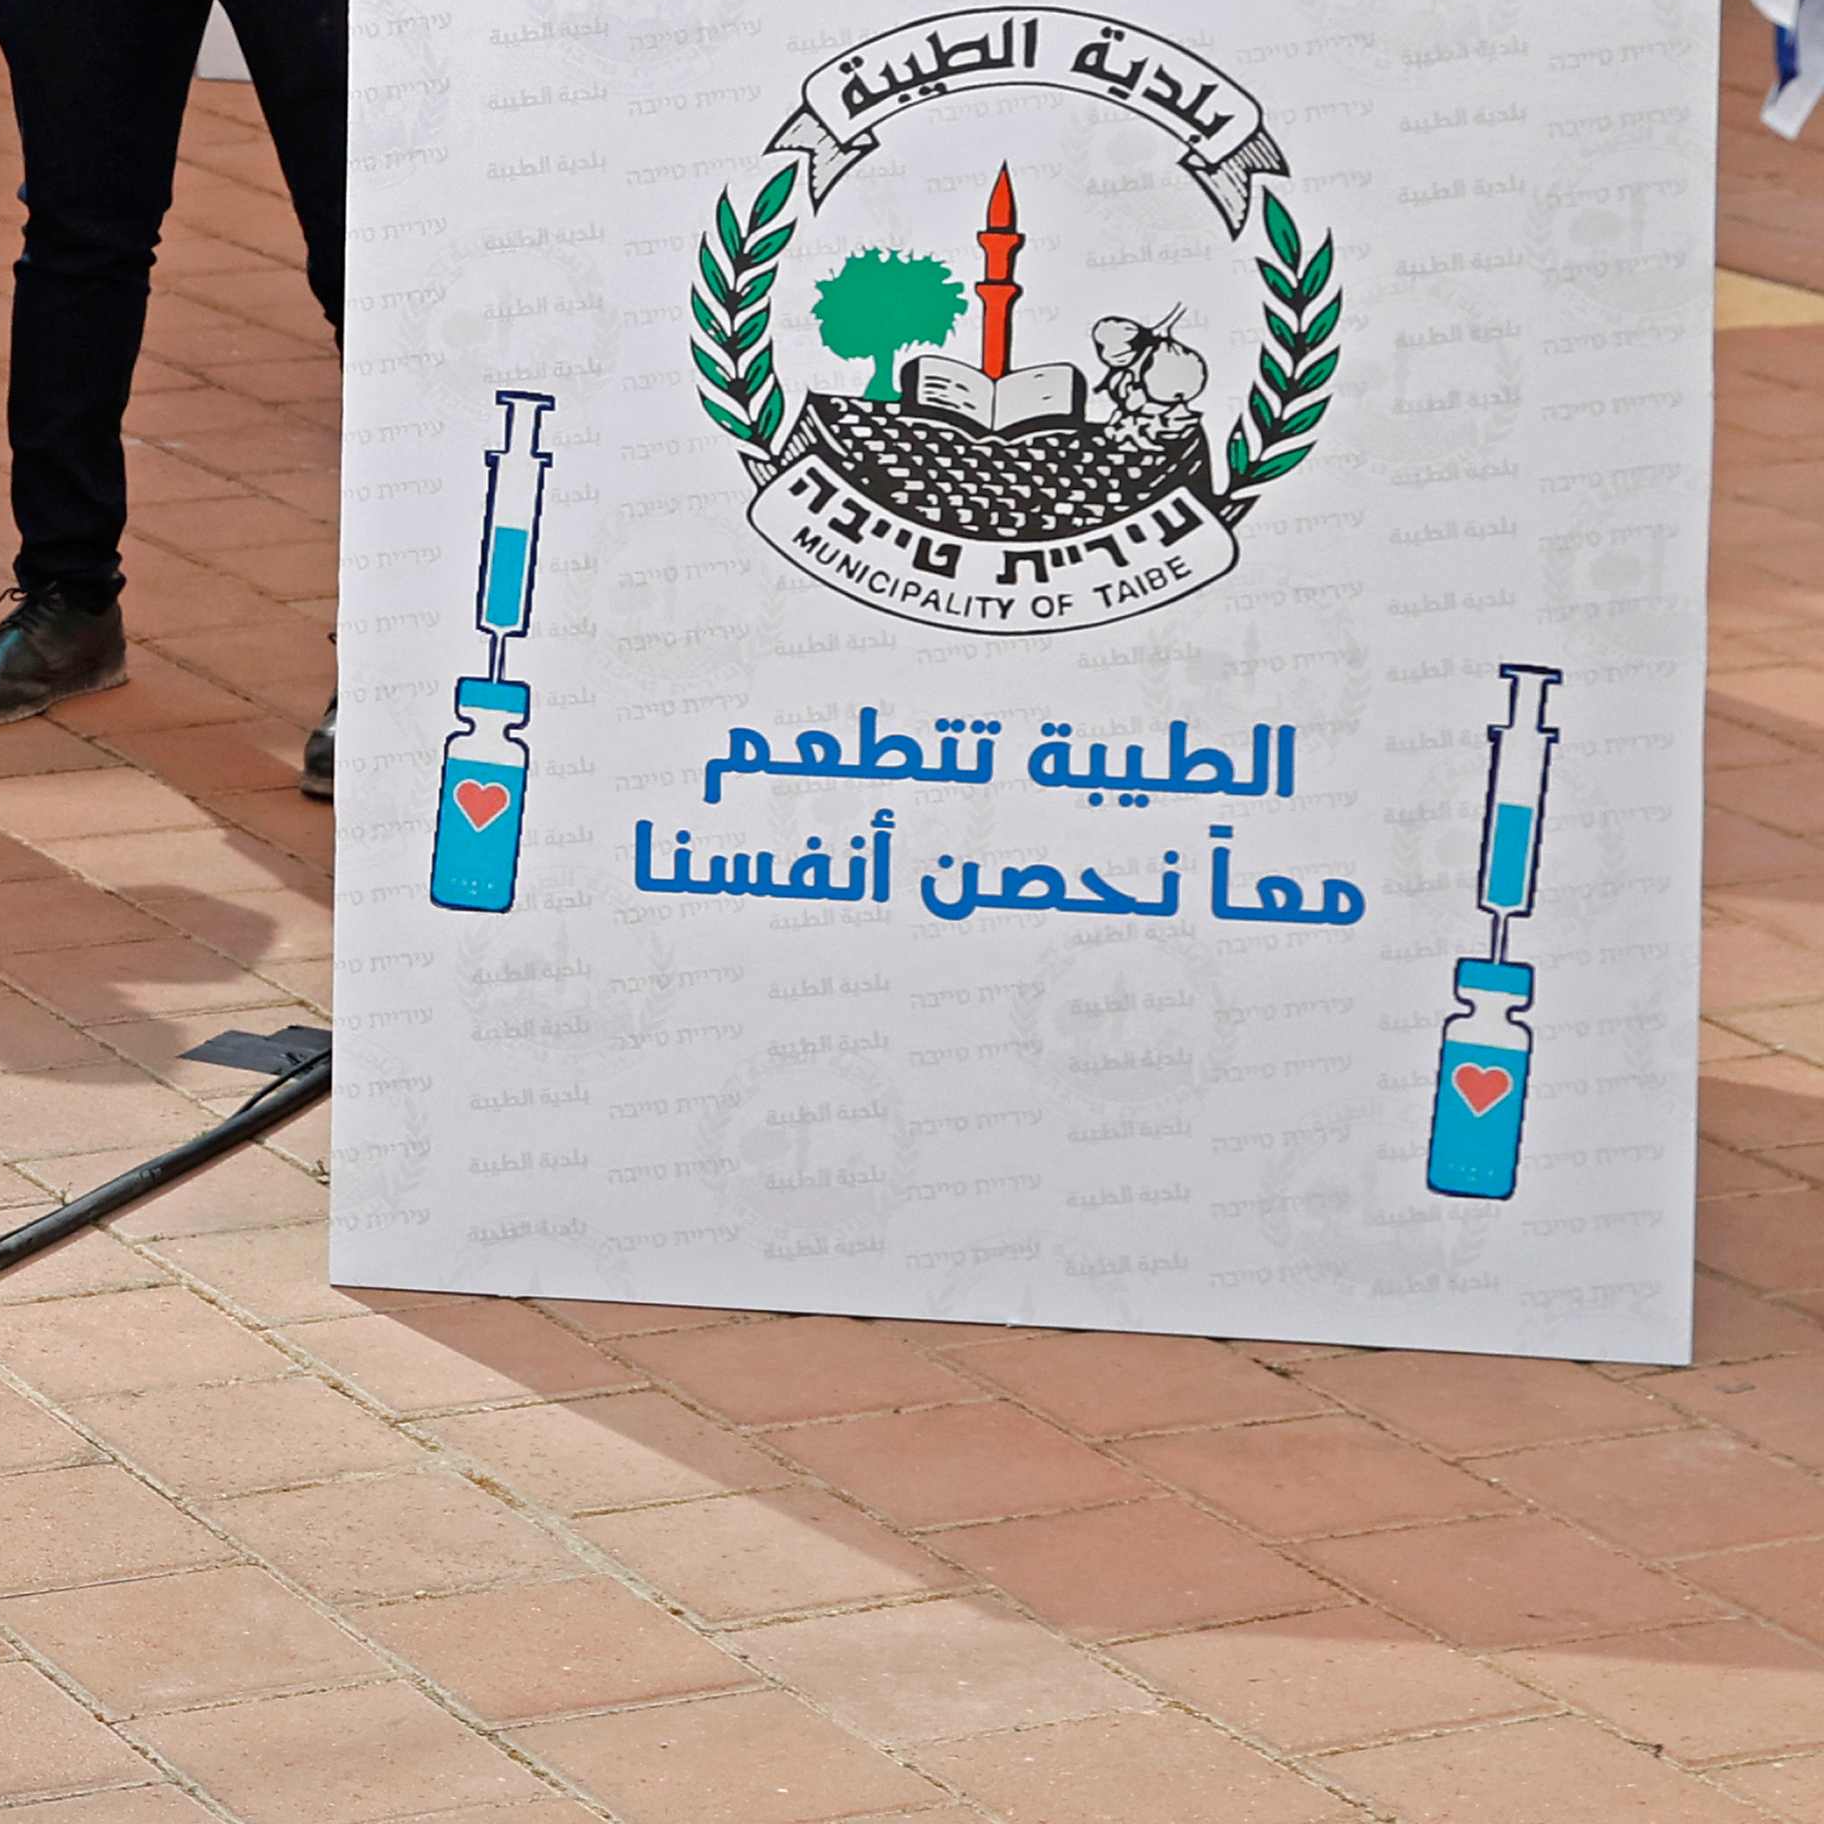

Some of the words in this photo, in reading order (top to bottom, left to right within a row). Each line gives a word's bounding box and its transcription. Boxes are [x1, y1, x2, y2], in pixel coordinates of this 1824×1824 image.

[839, 17, 1039, 119] الطيبة
[1071, 26, 1236, 144] بلدية
[789, 467, 963, 580] טייבה
[997, 496, 1205, 584] עיריית
[792, 526, 1016, 620] MUNICIPALITY
[1031, 594, 1074, 619] OF
[1093, 555, 1193, 610] TAIBE
[703, 706, 1003, 803] تتطعم
[1027, 719, 1297, 809] الطيبة
[634, 808, 896, 904] أنفسنا
[920, 850, 1181, 922] نحصن
[1208, 824, 1366, 926] معاً
